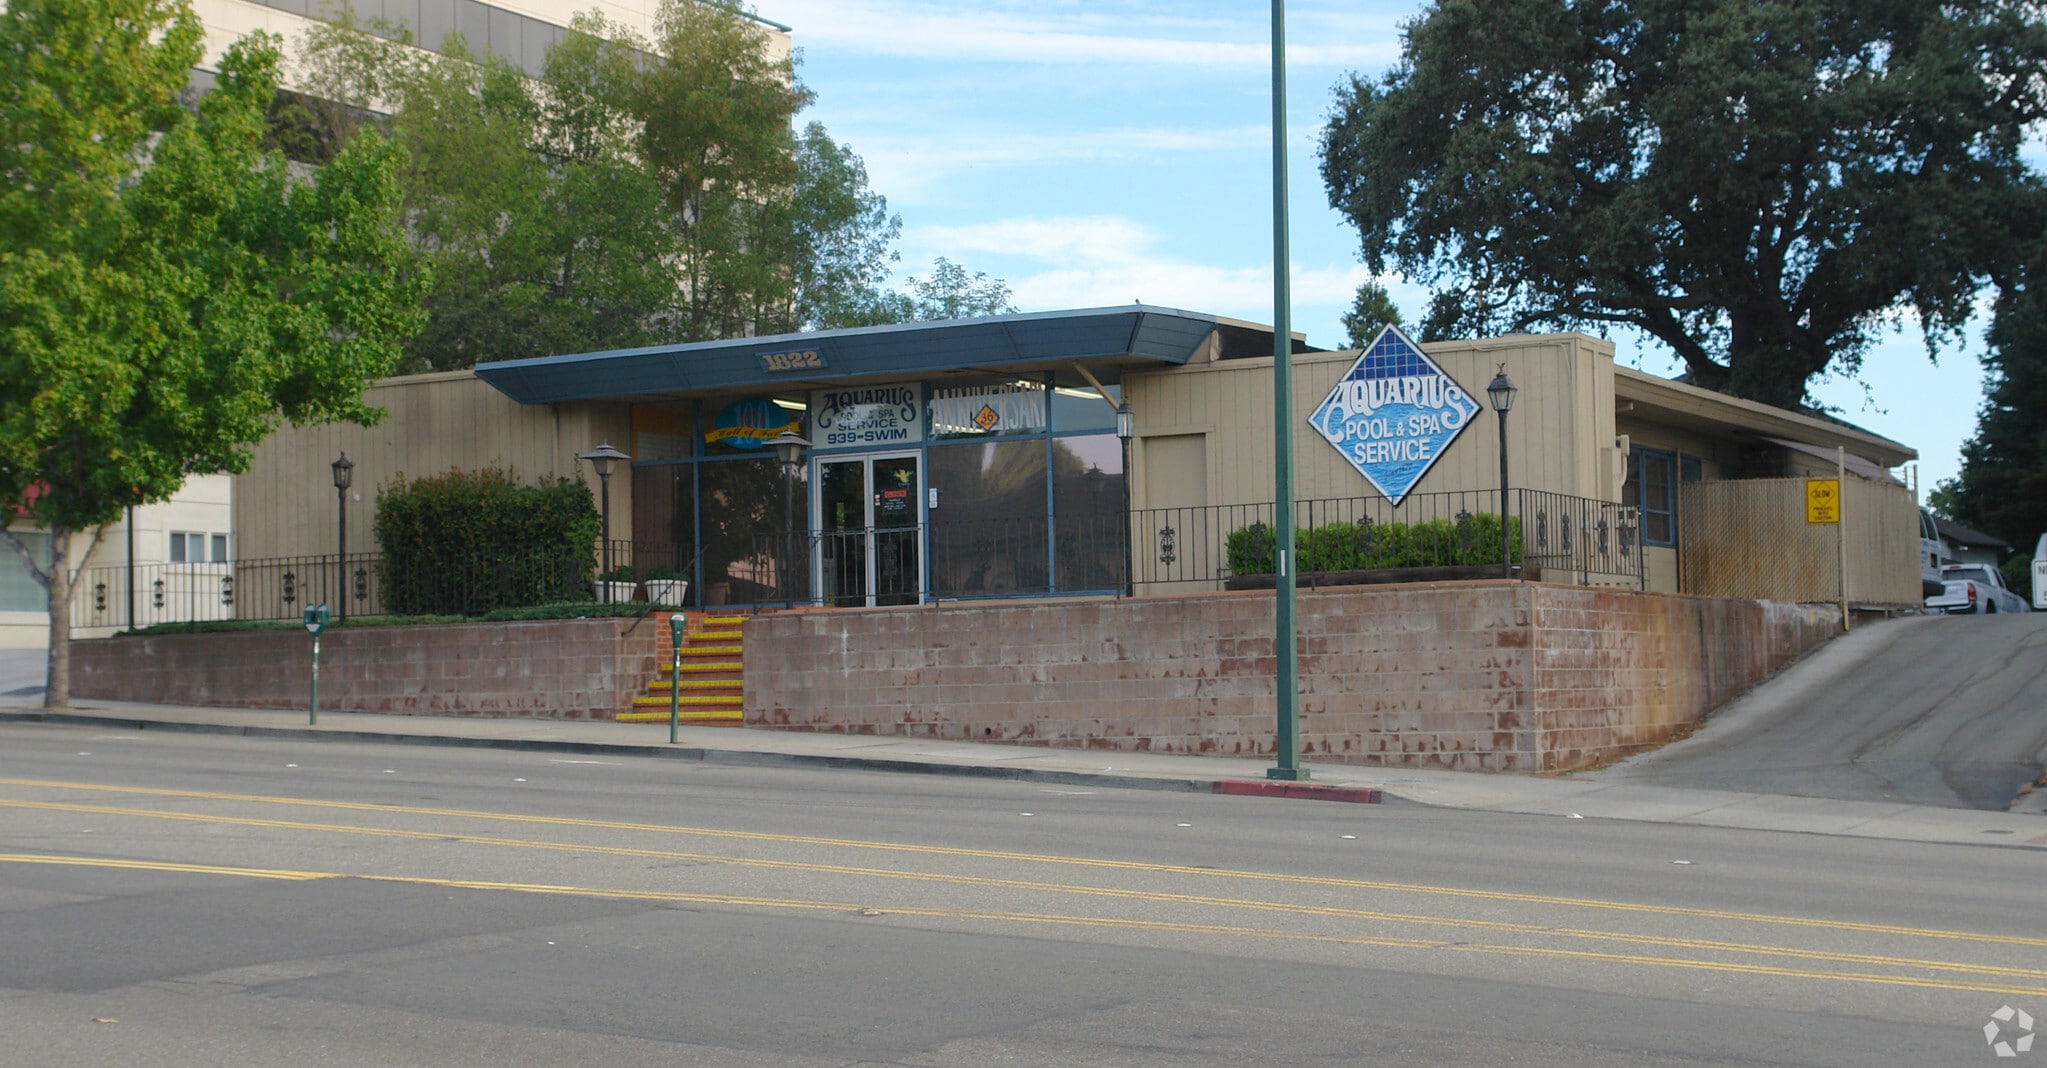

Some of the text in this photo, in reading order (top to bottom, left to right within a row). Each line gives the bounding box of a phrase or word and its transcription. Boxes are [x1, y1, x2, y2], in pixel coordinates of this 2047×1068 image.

[762, 351, 822, 370] 1822
[818, 387, 916, 429] AQUARIUS
[878, 407, 896, 419] SPA
[1323, 375, 1467, 443] AQUARIUS
[838, 418, 898, 431] SERVICE
[1346, 414, 1441, 440] POOL & SPA
[827, 428, 907, 444] 939-SWIM
[1354, 438, 1432, 464] SERVICE
